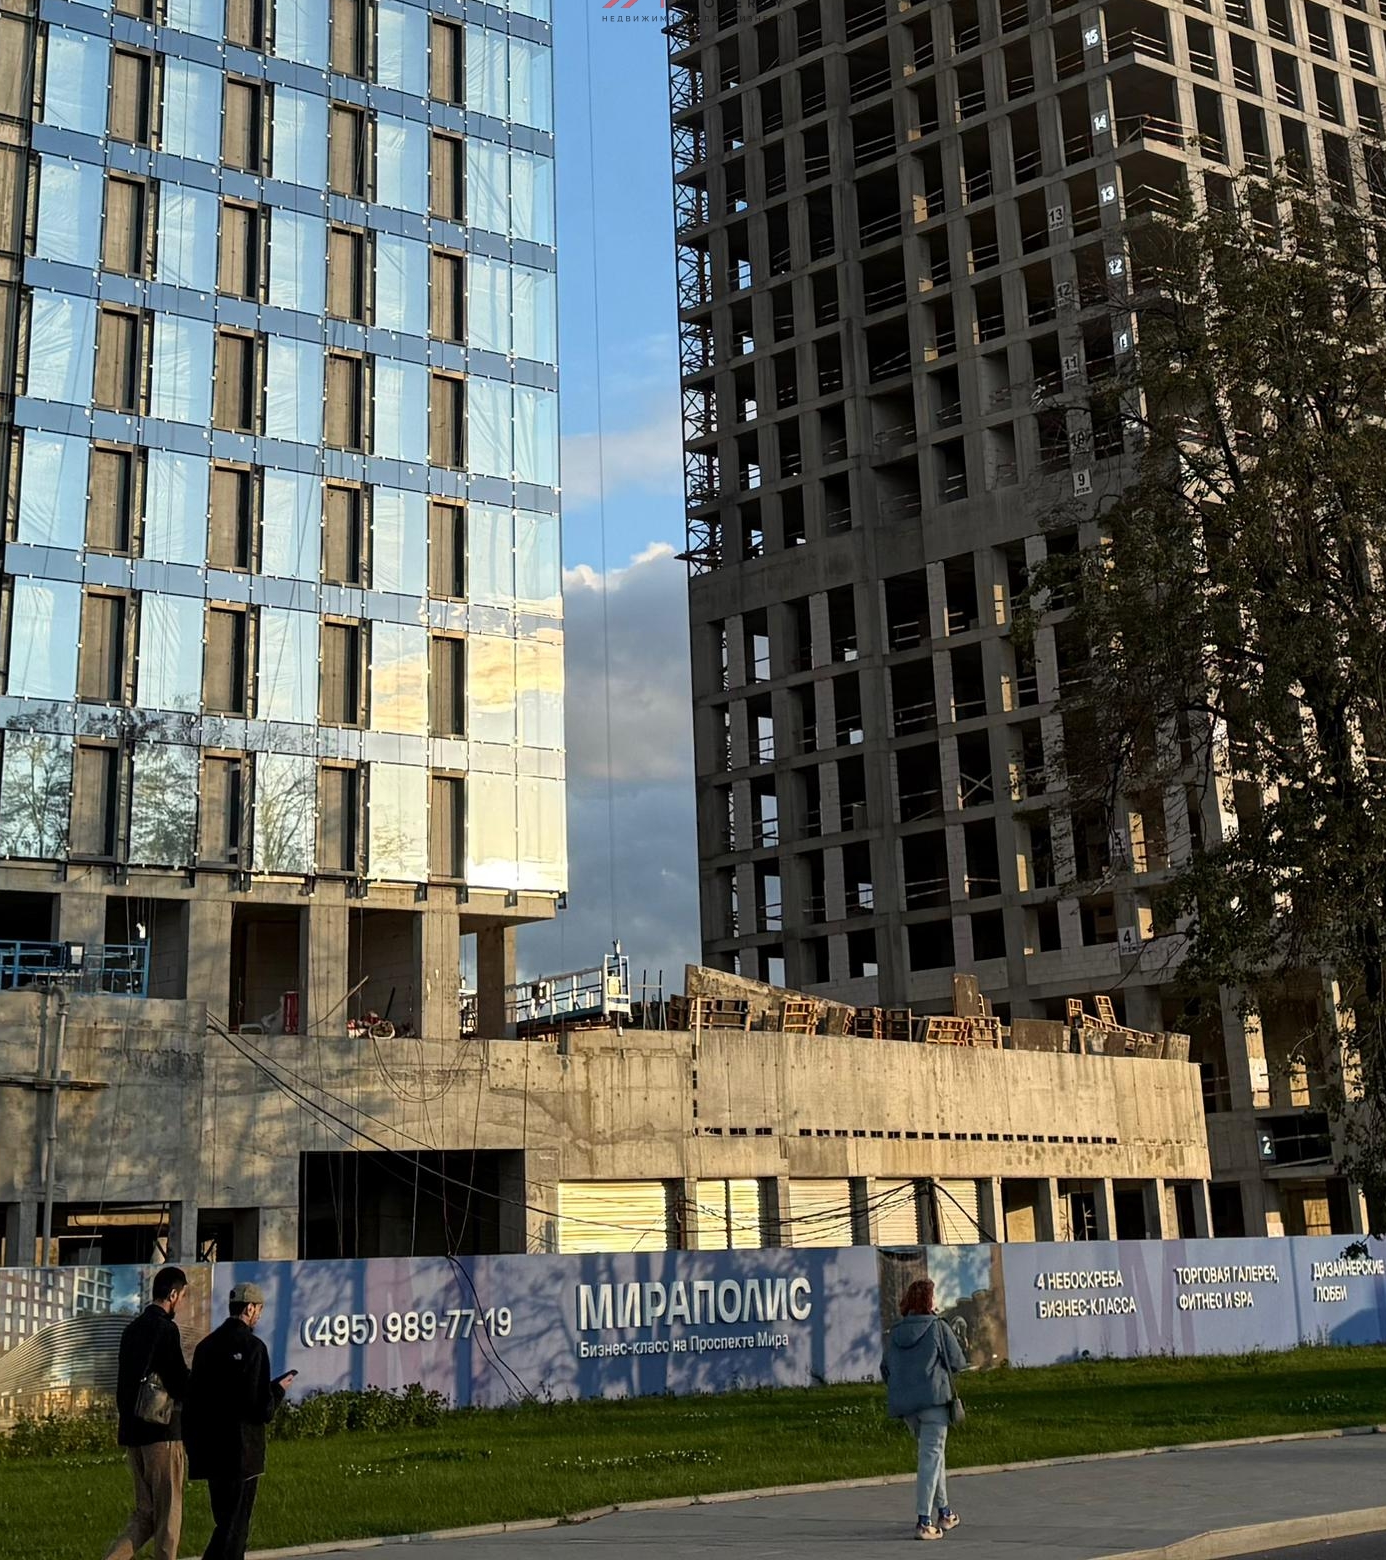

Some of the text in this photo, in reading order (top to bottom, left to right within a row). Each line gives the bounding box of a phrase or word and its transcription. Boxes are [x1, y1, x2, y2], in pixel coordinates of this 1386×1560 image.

[1094, 115, 1107, 130] 14
[1101, 186, 1115, 203] 13
[1049, 208, 1063, 222] 13
[1078, 473, 1085, 486] 9
[1124, 930, 1131, 943] 4
[1174, 1265, 1280, 1285] ТОРГОВАЯ ГАЛЕРЕЯ,
[1311, 1259, 1385, 1280] ДИЗАЙНЕРСКИЕ
[1036, 1270, 1124, 1290] 4 НЕБОСКРЕБА
[575, 1276, 812, 1332] МИРАПОЛИС
[1037, 1296, 1137, 1319] БИЗНЕС-КЛАССА
[1178, 1291, 1254, 1311] ФИТНЕС И SPA
[301, 1307, 512, 1350] (495) 989-77-19
[578, 1331, 789, 1359] Бизнес-класс на Проспекте Мира
